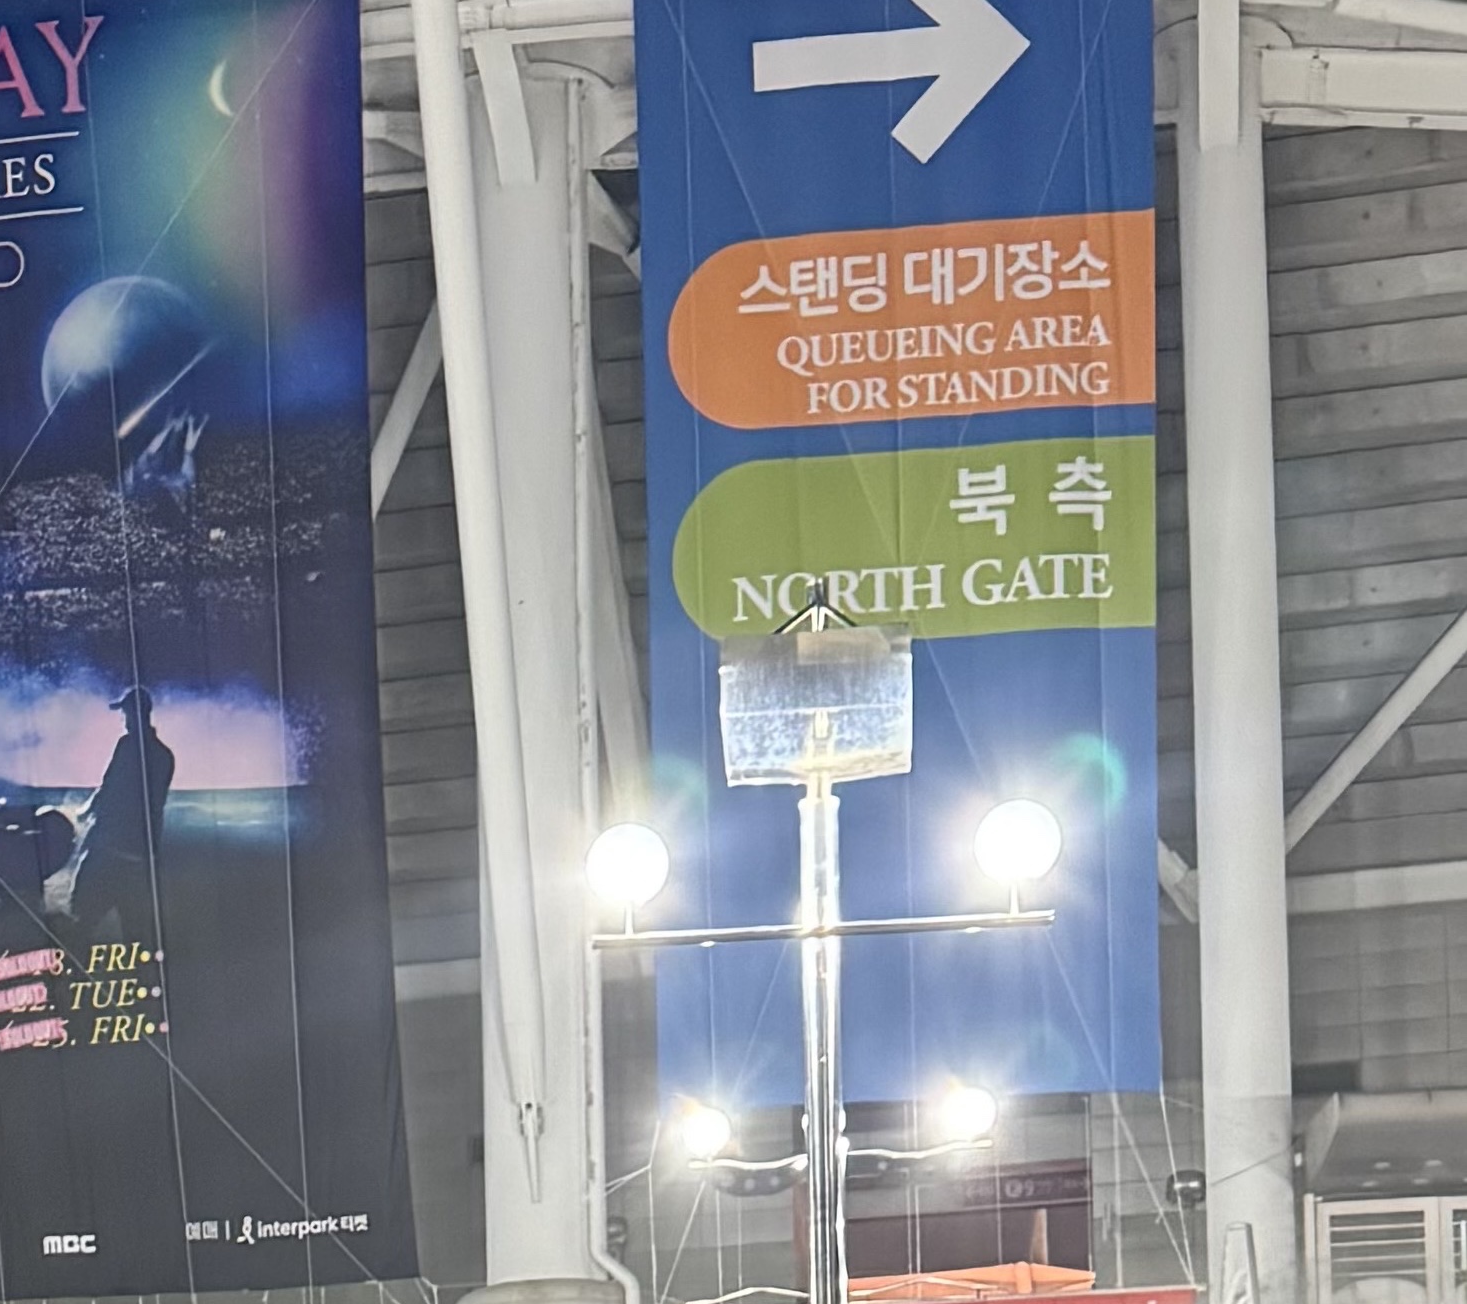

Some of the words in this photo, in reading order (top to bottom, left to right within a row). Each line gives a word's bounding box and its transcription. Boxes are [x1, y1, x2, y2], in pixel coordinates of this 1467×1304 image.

[736, 252, 888, 318] 스탠딩
[902, 239, 1111, 305] 대기장소
[777, 320, 995, 378] QUEUEING
[1004, 314, 1111, 351] AREA
[807, 378, 892, 415] FOR
[897, 361, 1110, 409] STANDING
[731, 563, 946, 623] NORTH
[961, 552, 1115, 608] GATE
[86, 942, 141, 974] FRI
[69, 978, 138, 1011] TUE
[90, 1014, 144, 1045] FRI
